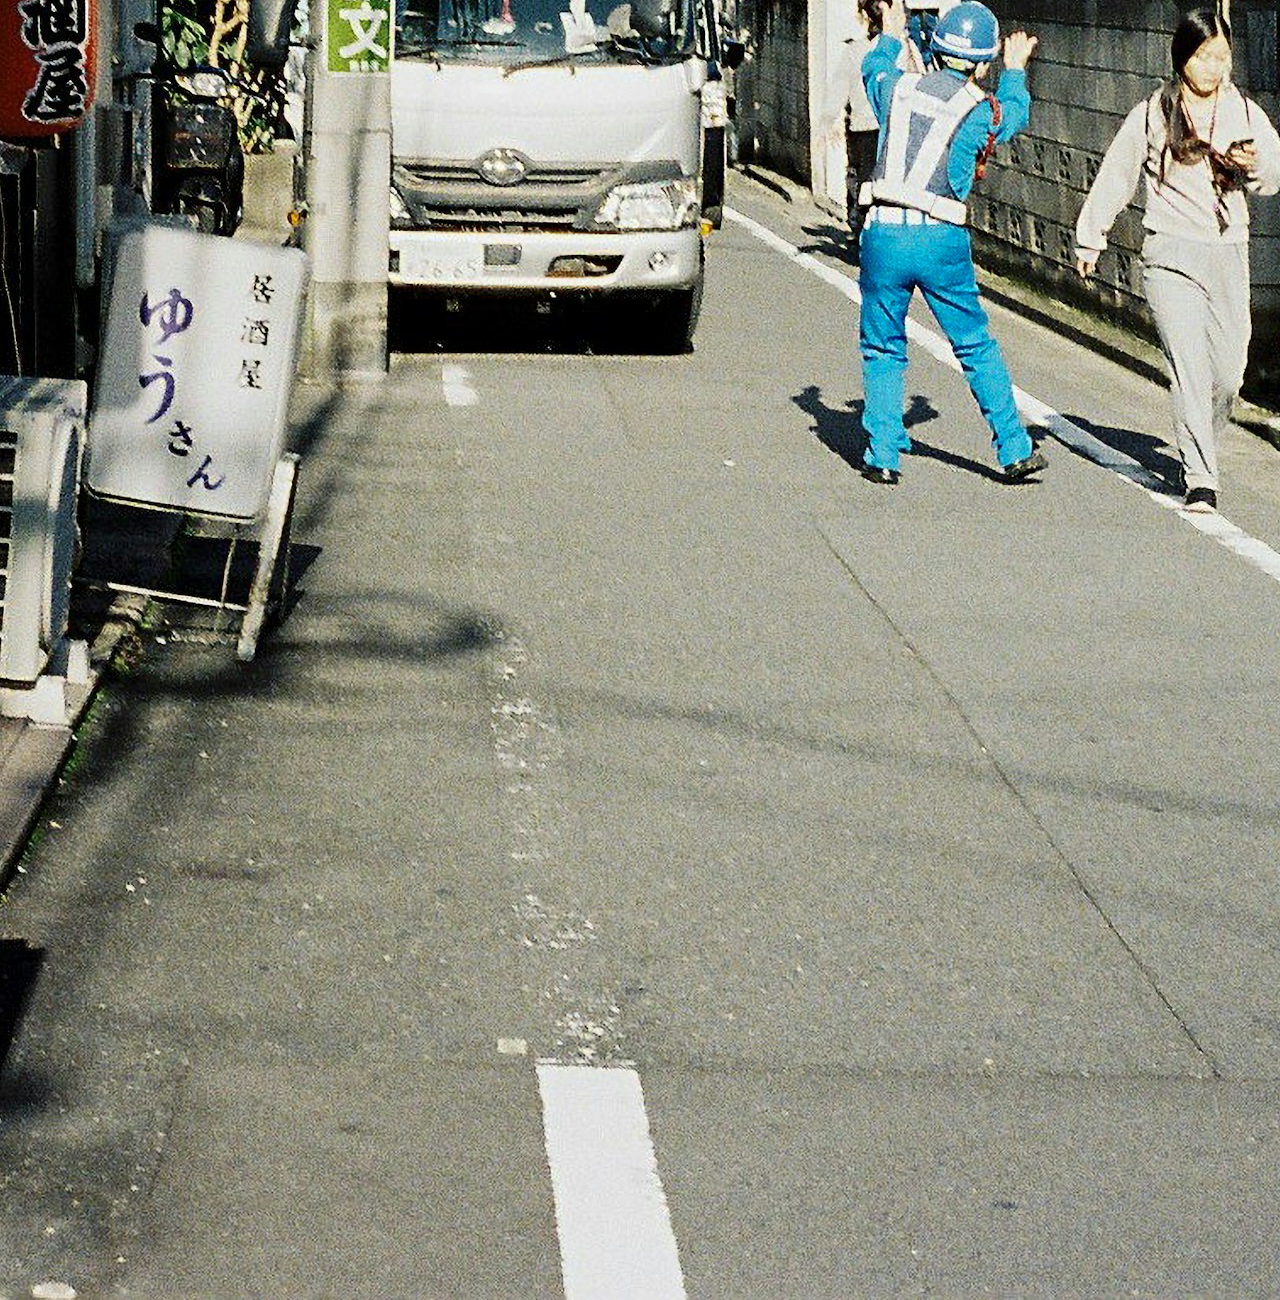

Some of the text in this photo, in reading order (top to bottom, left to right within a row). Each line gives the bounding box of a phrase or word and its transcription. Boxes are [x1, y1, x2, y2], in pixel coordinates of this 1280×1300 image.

[339, 1, 388, 58] 文
[138, 288, 226, 491] ゆうさん
[241, 273, 275, 390] 居酒屋
